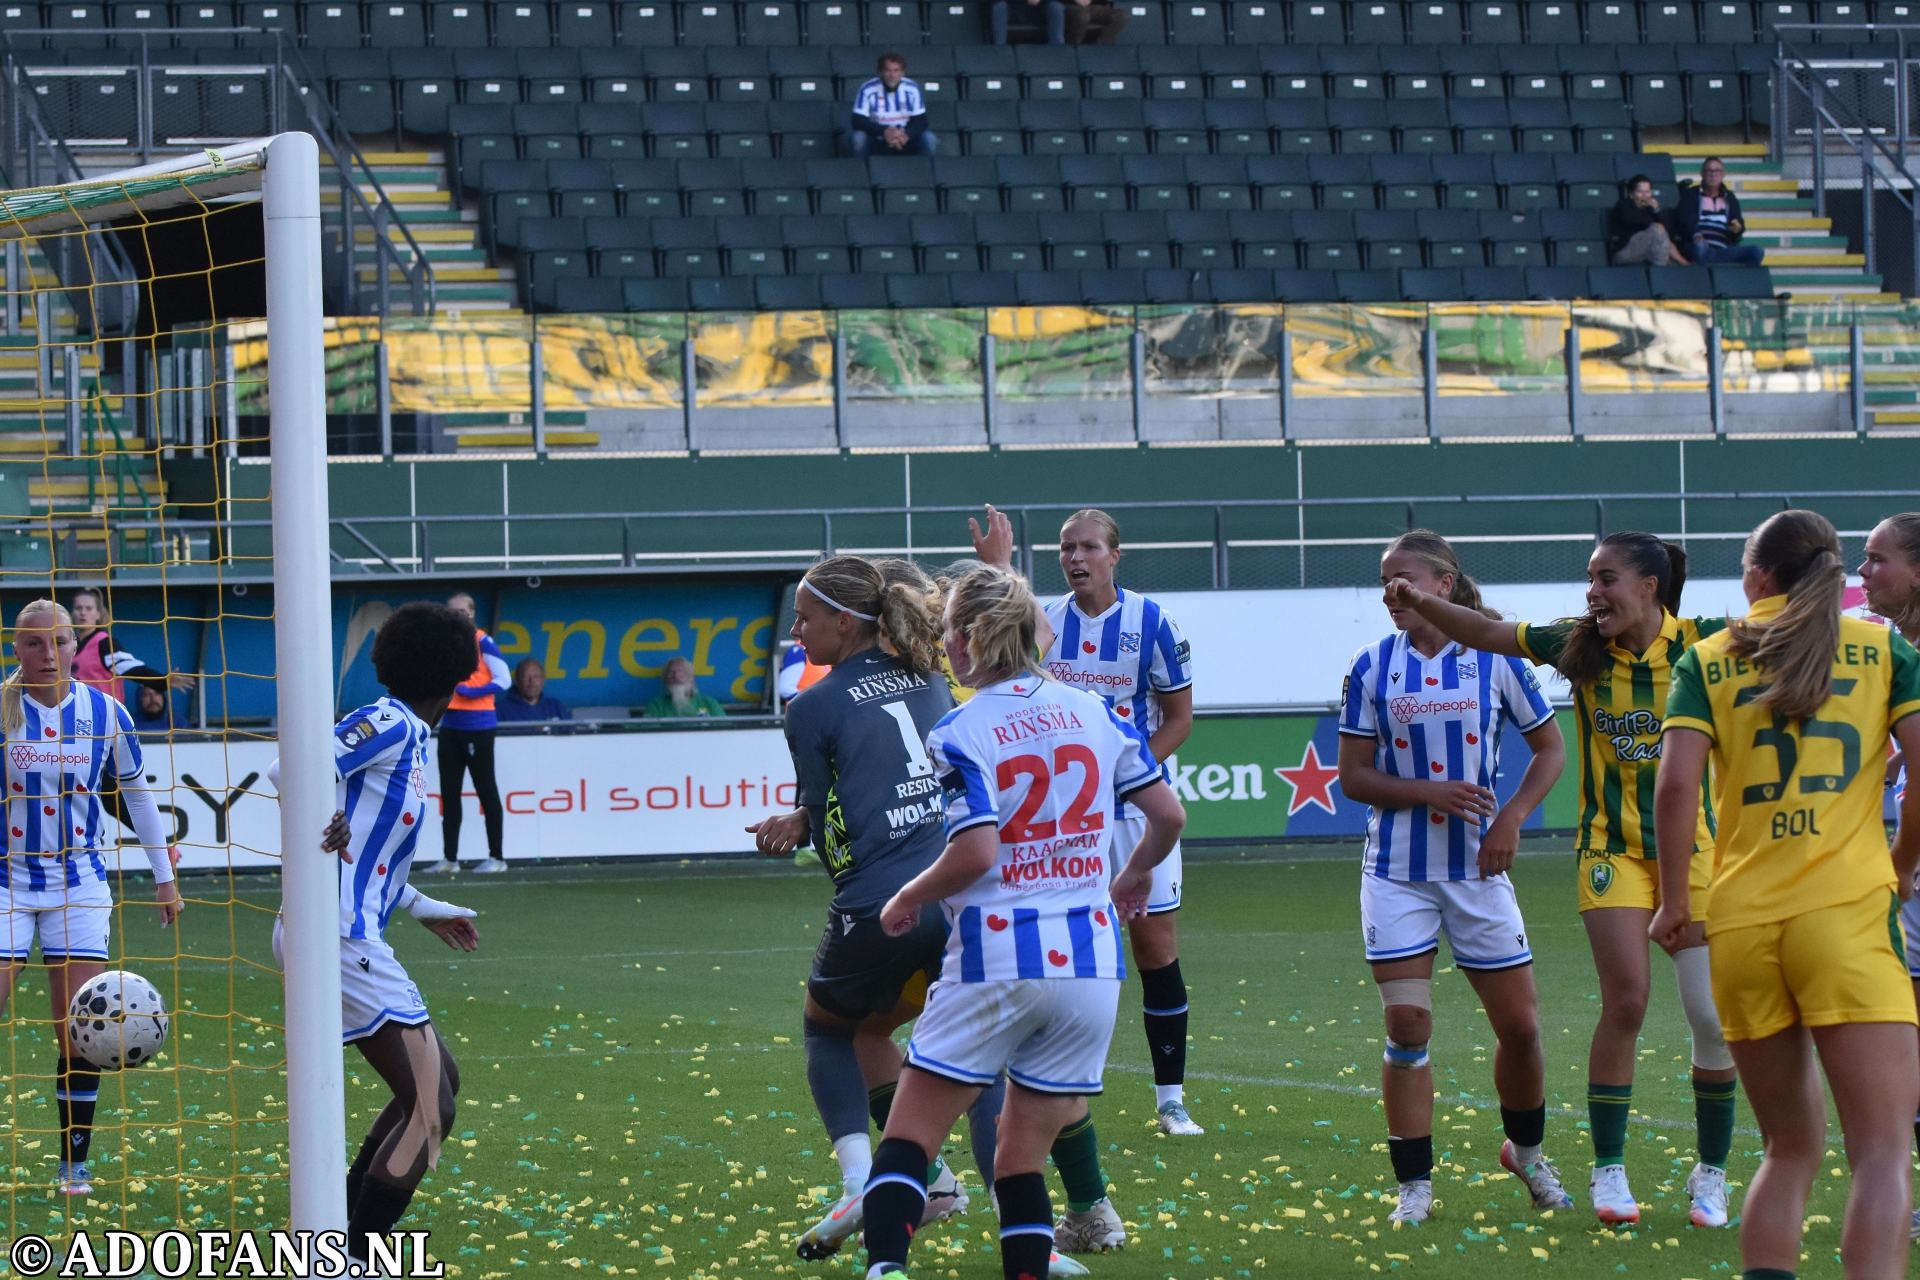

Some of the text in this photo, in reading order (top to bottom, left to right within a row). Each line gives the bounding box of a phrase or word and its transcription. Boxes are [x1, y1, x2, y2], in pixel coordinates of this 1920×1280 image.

[210, 152, 222, 168] TOP
[846, 672, 927, 702] RINSMA
[1051, 666, 1133, 688] Moofpeople
[1005, 703, 1061, 721] MODEPLEIN
[1396, 697, 1478, 715] Moofpeople
[880, 700, 934, 778] 1
[992, 710, 1084, 746] RINSMA
[15, 750, 90, 766] Moofpeople
[995, 743, 1105, 844] 22
[1771, 808, 1822, 841] BOL
[1001, 856, 1104, 885] WOLKOM
